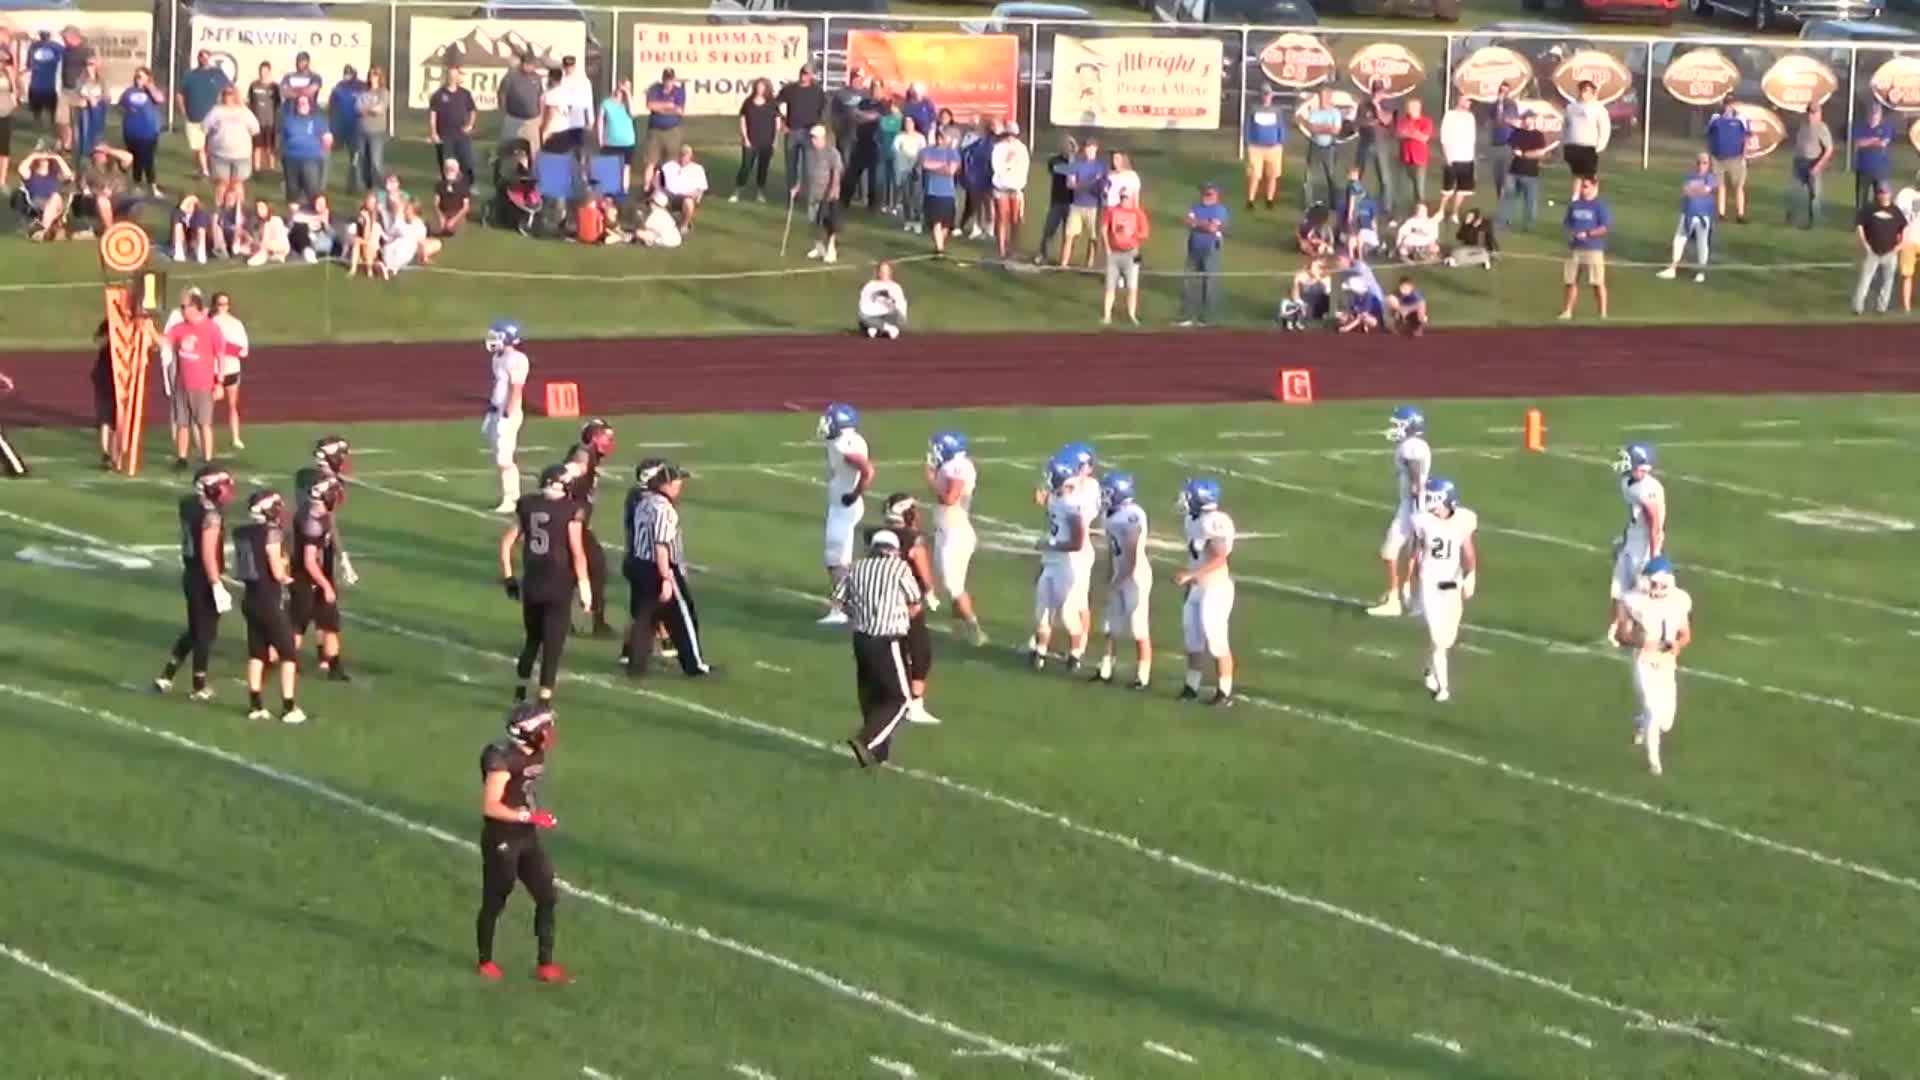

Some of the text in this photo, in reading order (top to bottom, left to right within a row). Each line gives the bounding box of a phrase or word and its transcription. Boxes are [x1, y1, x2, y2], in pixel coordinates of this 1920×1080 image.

[688, 31, 777, 45] THOMAS
[640, 50, 775, 64] DRUG STORE
[1288, 373, 1309, 399] G
[553, 388, 576, 409] 10
[530, 511, 550, 555] 5
[1430, 537, 1452, 560] 21
